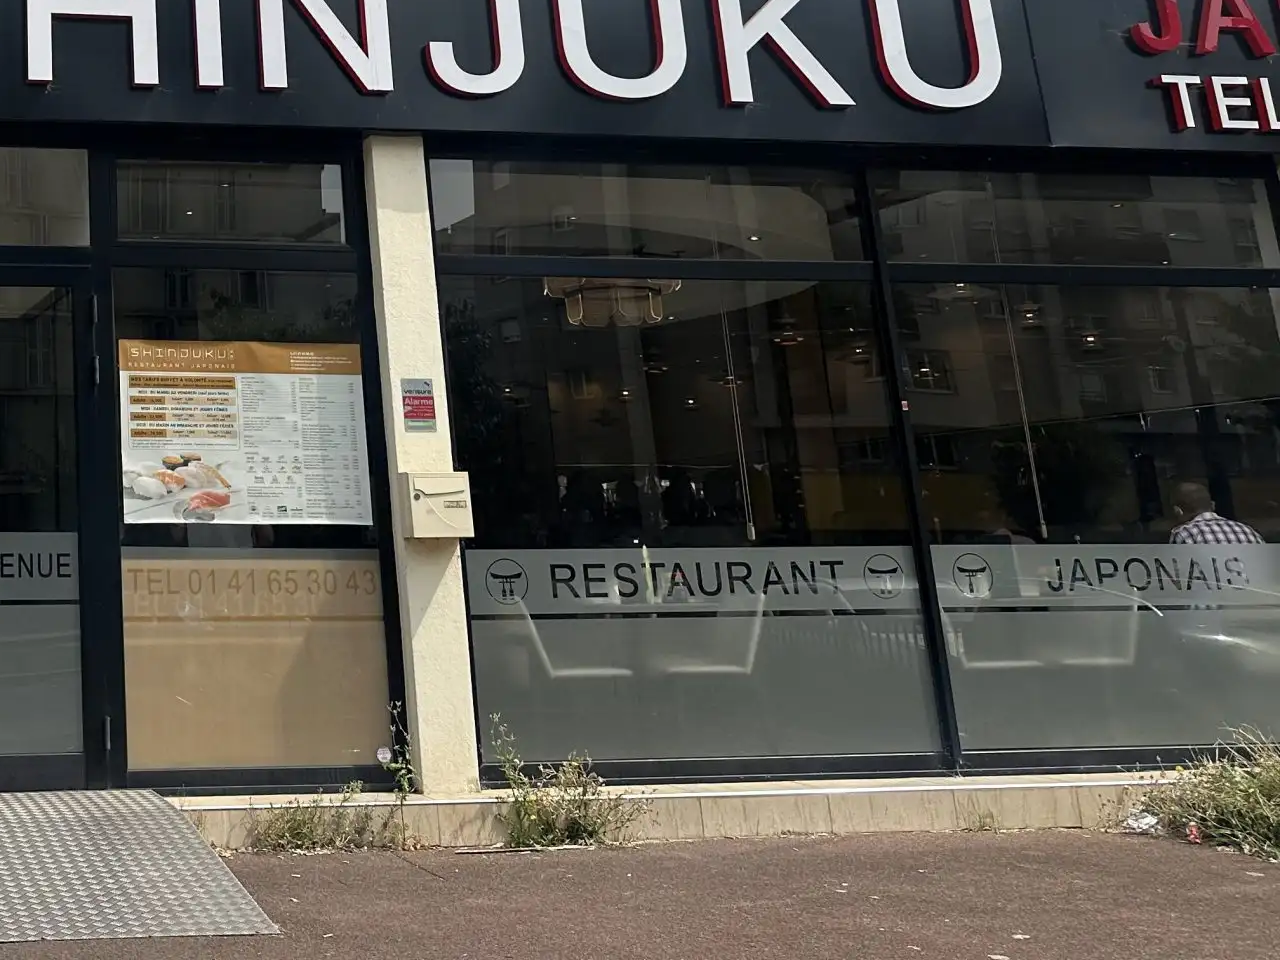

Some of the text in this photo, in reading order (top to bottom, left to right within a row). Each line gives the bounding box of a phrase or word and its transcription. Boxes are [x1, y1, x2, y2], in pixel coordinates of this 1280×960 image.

[404, 397, 433, 406] Alarme
[126, 568, 377, 597] TEL 01 41 65 30 43
[548, 559, 844, 600] RESTAURANT
[1046, 556, 1251, 592] JAPONAIS
